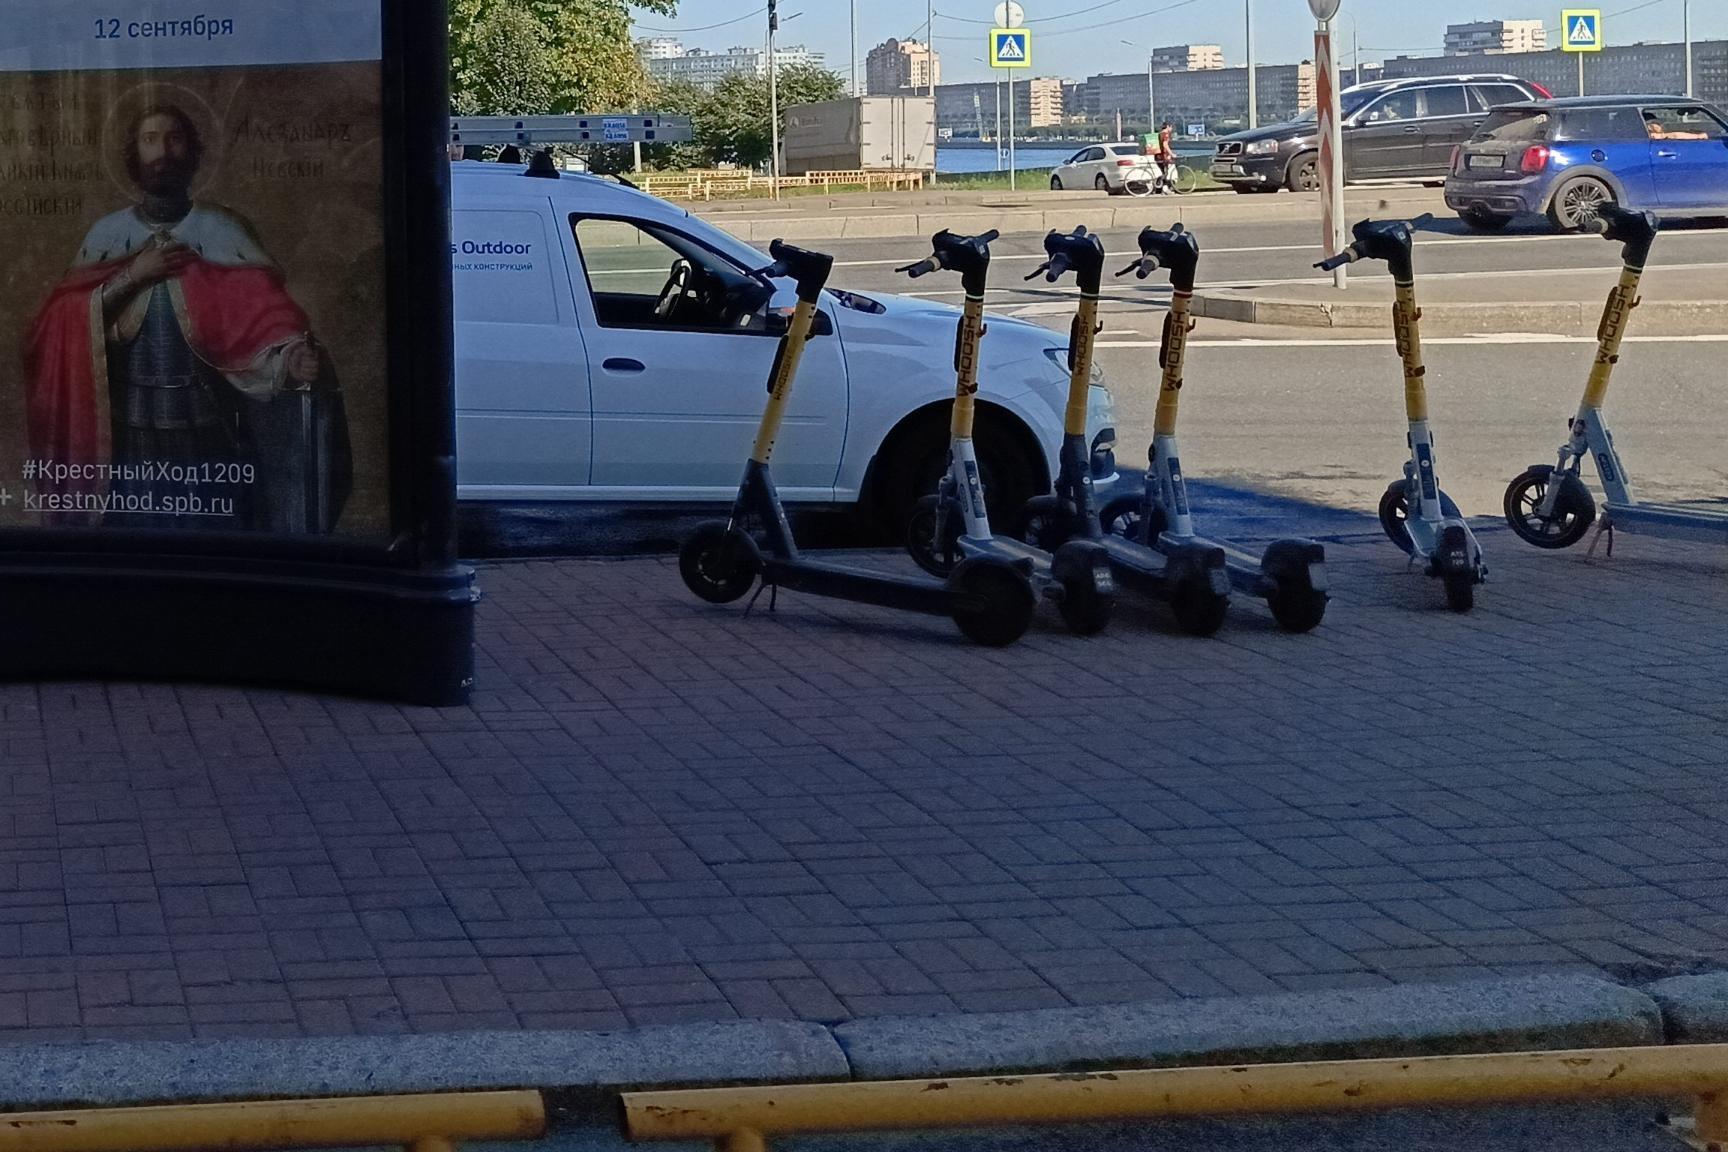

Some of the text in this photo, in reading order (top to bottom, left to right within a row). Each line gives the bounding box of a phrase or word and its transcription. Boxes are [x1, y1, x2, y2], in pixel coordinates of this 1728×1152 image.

[95, 14, 234, 41] 12 сентября
[462, 240, 532, 254] Outdoor
[1594, 284, 1630, 364] WHOOSH
[957, 315, 976, 396] WHOOSH
[1164, 310, 1185, 392] WHOOSH
[22, 459, 255, 485] #КрестныйХод1209
[23, 489, 235, 516] krestnyhod.spb.ru
